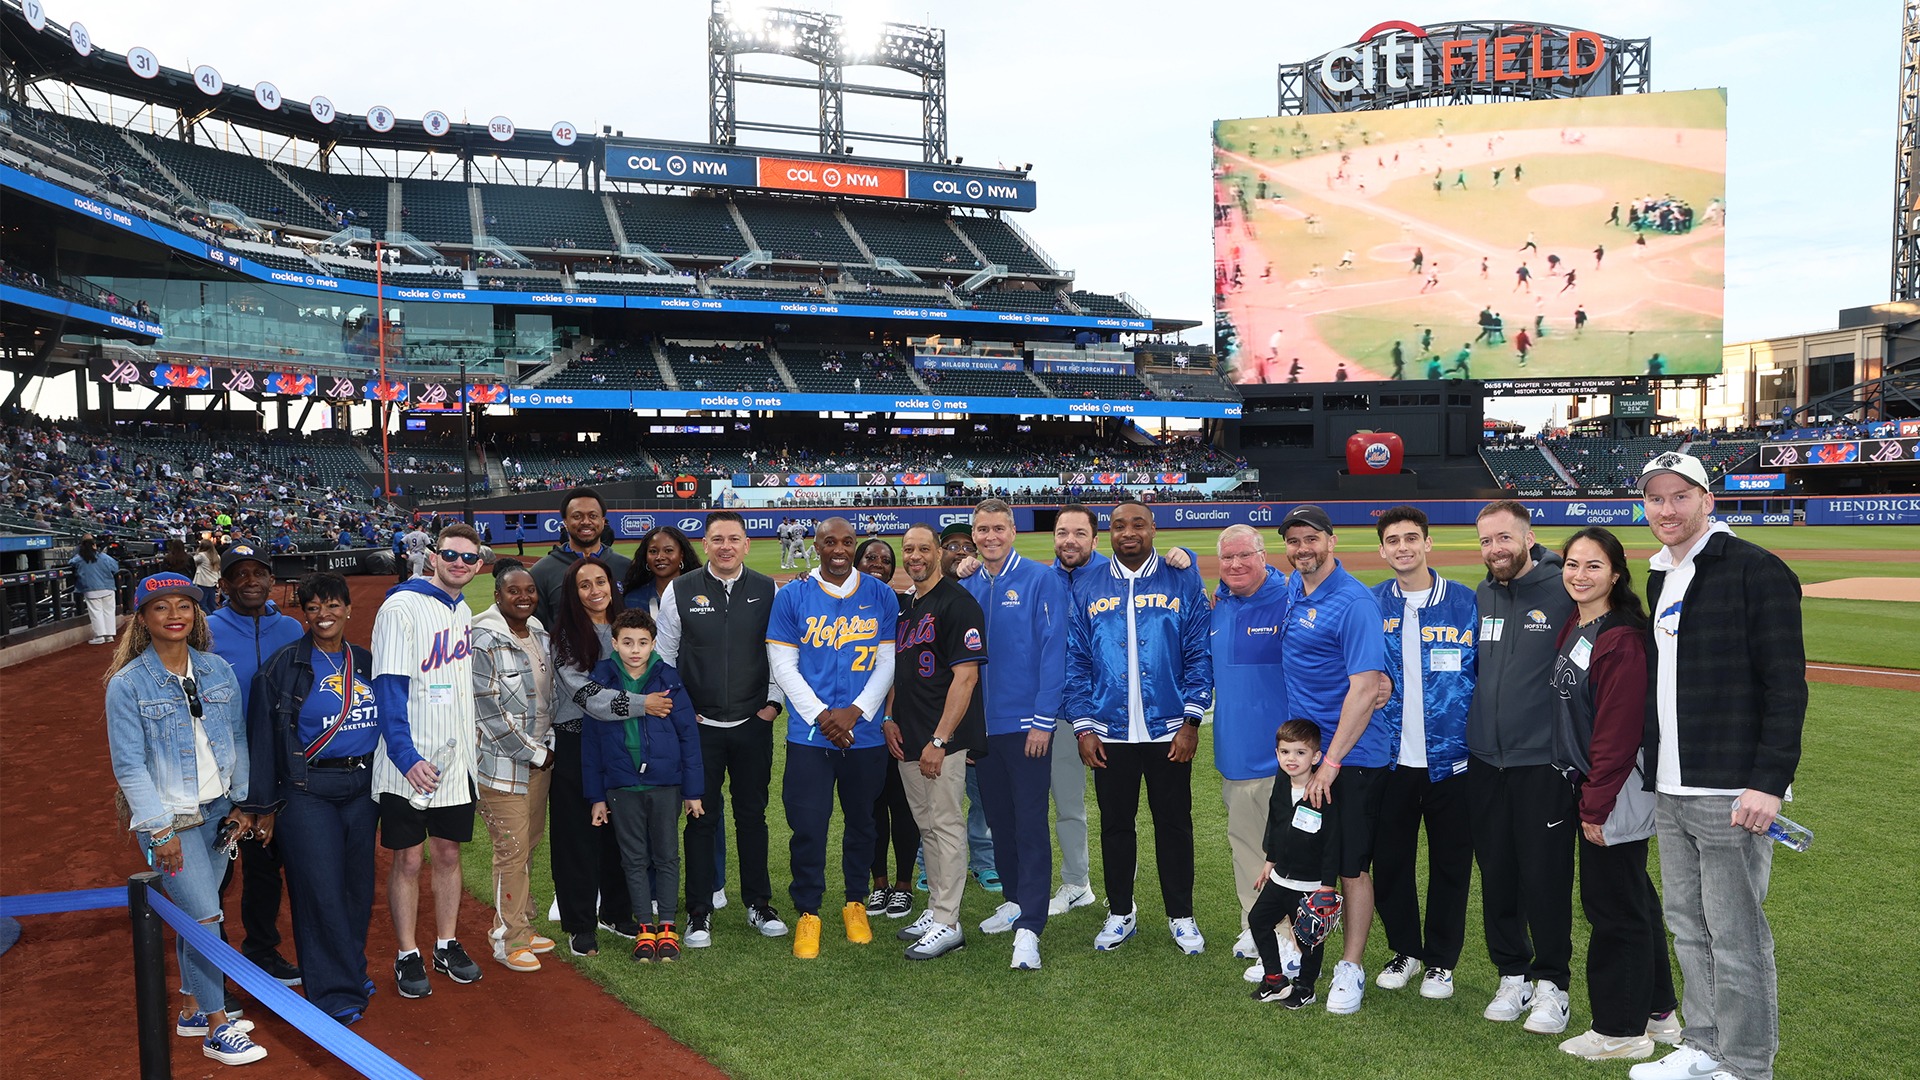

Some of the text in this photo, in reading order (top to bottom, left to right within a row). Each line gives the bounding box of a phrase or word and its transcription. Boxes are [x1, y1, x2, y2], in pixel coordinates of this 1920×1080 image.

[28, 2, 39, 20] 17
[75, 29, 87, 48] 36
[136, 54, 150, 72] 31
[1321, 31, 1606, 92] citi FIELD
[201, 72, 215, 88] 41
[262, 89, 275, 103] 14
[315, 102, 330, 117] 37
[491, 123, 512, 134] SHEA
[556, 128, 572, 140] 42
[627, 155, 661, 171] COL
[692, 160, 728, 176] NYM
[786, 168, 818, 183] COL
[846, 173, 879, 188] NYM
[932, 180, 962, 195] COL
[987, 185, 1018, 199] NYM
[74, 198, 132, 227] rockies mets
[271, 271, 338, 288] rockies mets
[398, 289, 466, 299] rockies mets
[532, 294, 597, 304] rockies mets
[661, 299, 690, 307] rockies
[780, 304, 838, 313] rockies mets
[893, 308, 947, 318] rockies mets
[111, 315, 163, 336] rockies mets
[1129, 320, 1145, 328] mets
[941, 361, 970, 369] MILAGRO
[544, 394, 573, 404] mets
[701, 395, 739, 406] rockies
[755, 397, 782, 406] mets
[895, 399, 929, 408] rockies
[944, 400, 967, 409] mets
[1069, 402, 1100, 412] rockies
[1113, 404, 1134, 412] mets
[656, 482, 695, 494] citi 10
[1739, 480, 1770, 489] $1,500
[794, 489, 819, 498] Coors
[1186, 510, 1230, 520] Guardian
[1248, 508, 1272, 521] citi
[1565, 503, 1587, 516] HG
[1587, 509, 1630, 517] HAUGLAND
[1587, 516, 1614, 524] GROUP
[1726, 515, 1752, 523] GOYA
[1763, 515, 1790, 523] GOYA
[1866, 513, 1896, 521] GIN
[412, 538, 418, 547] 9
[334, 557, 358, 568] DELTA
[1134, 594, 1180, 614] STRA
[801, 615, 878, 651] Hofstra
[1421, 626, 1473, 647] STRA
[851, 646, 878, 672] 27
[918, 650, 935, 678] 9
